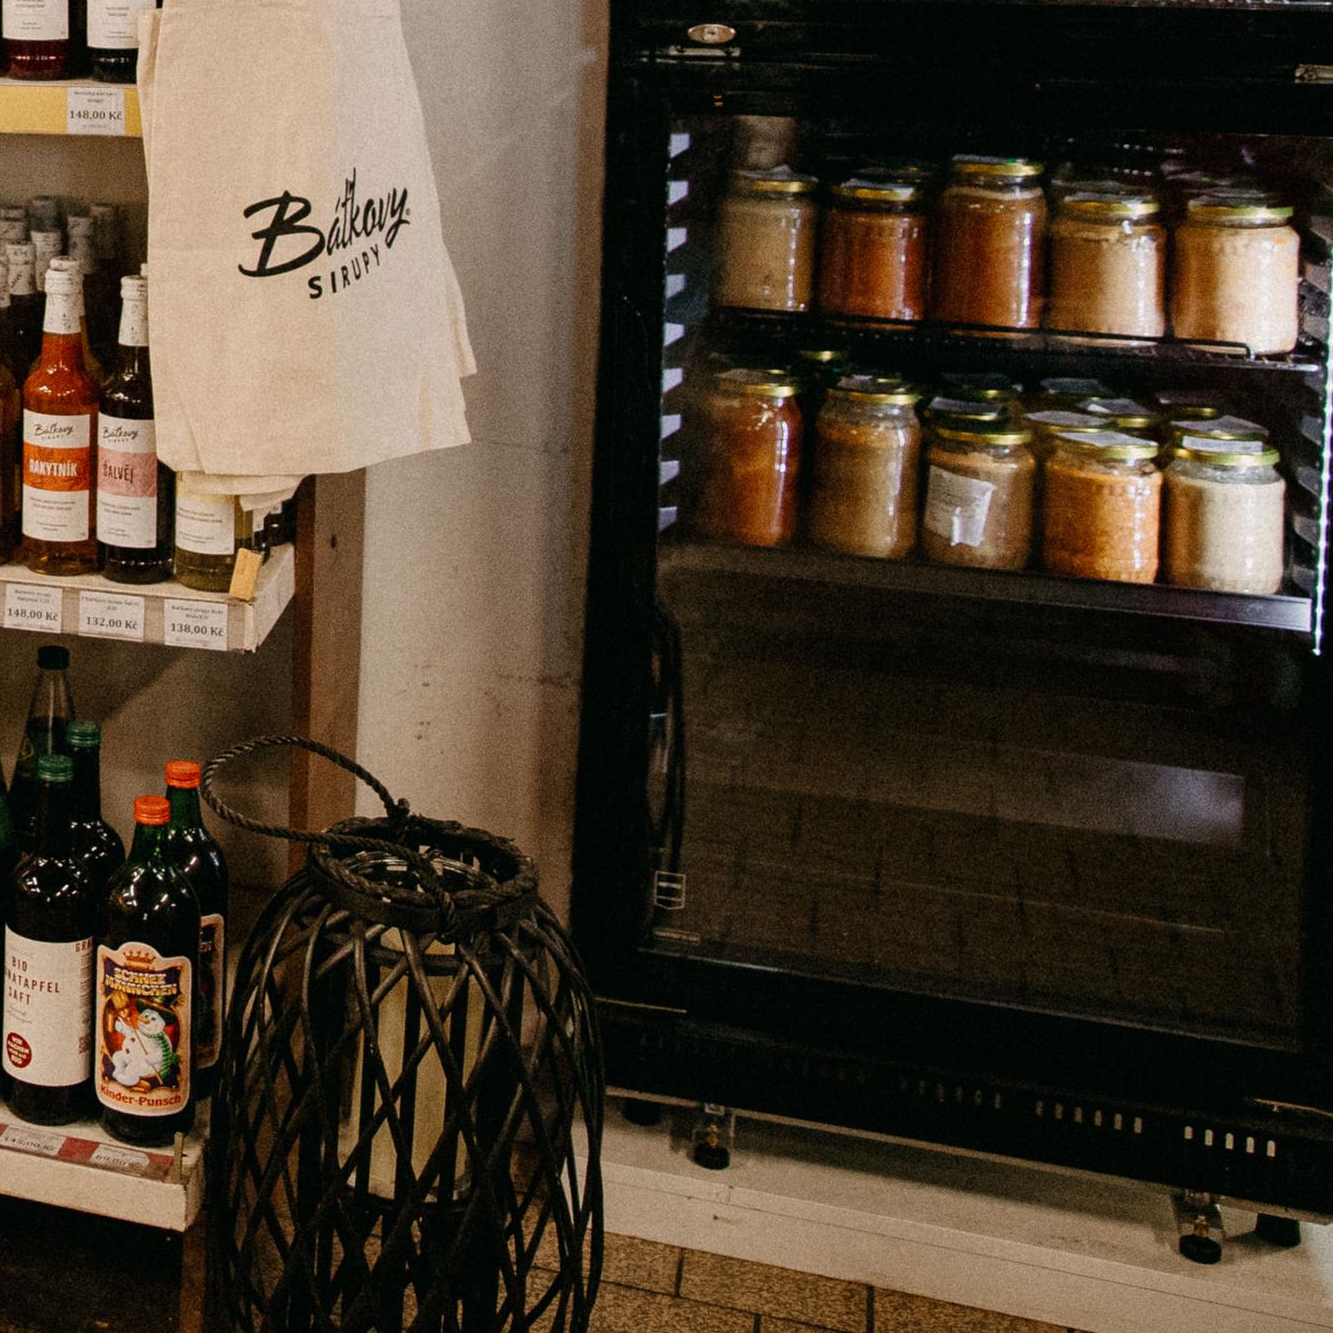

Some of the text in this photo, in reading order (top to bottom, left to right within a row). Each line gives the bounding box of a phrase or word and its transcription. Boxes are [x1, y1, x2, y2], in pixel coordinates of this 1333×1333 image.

[69, 110, 123, 121] 148,00 Kč
[238, 167, 411, 277] Báťkovy
[308, 244, 380, 299] SIRUPY
[34, 423, 74, 438] Báťkovy
[29, 459, 78, 477] RAKYTNÍK
[102, 460, 134, 486] ŠALVĚJ
[7, 607, 60, 622] 148,00 Kč
[86, 616, 139, 630] 132,00 Kč
[170, 623, 225, 638] 138,00 Kč
[11, 956, 28, 971] BIO
[8, 986, 32, 1005] SAFT
[100, 1084, 181, 1106] Kinder-Punsch
